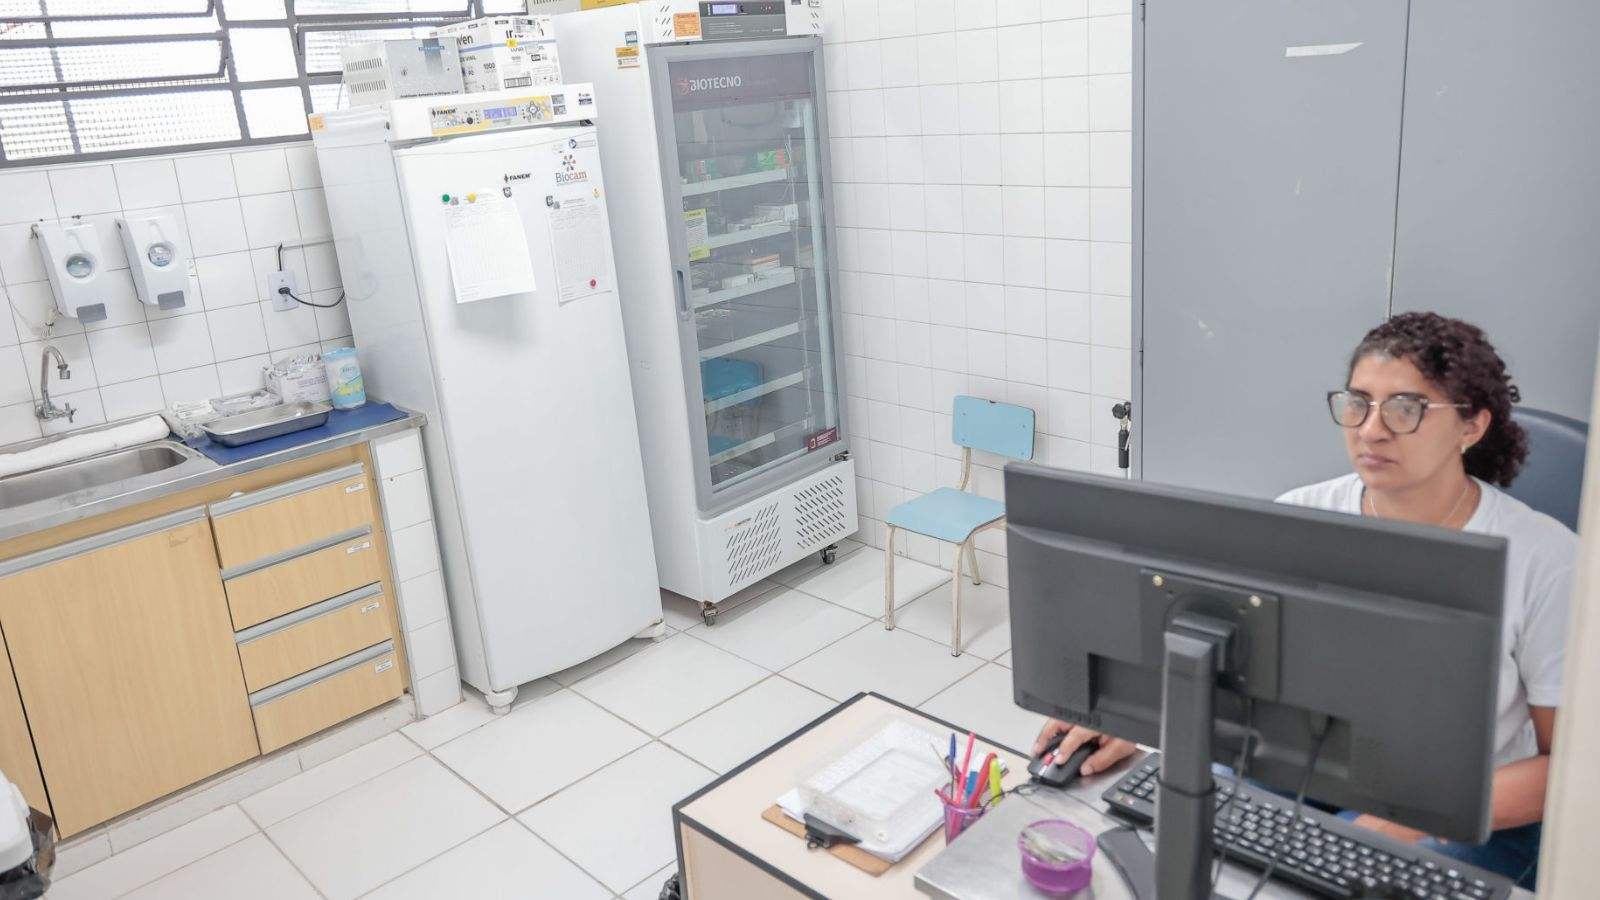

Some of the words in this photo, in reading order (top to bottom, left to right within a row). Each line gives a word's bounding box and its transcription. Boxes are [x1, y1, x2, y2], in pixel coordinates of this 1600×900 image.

[690, 76, 742, 91] BIOTECNO
[509, 173, 531, 181] FANEM
[555, 171, 587, 183] Biocam
